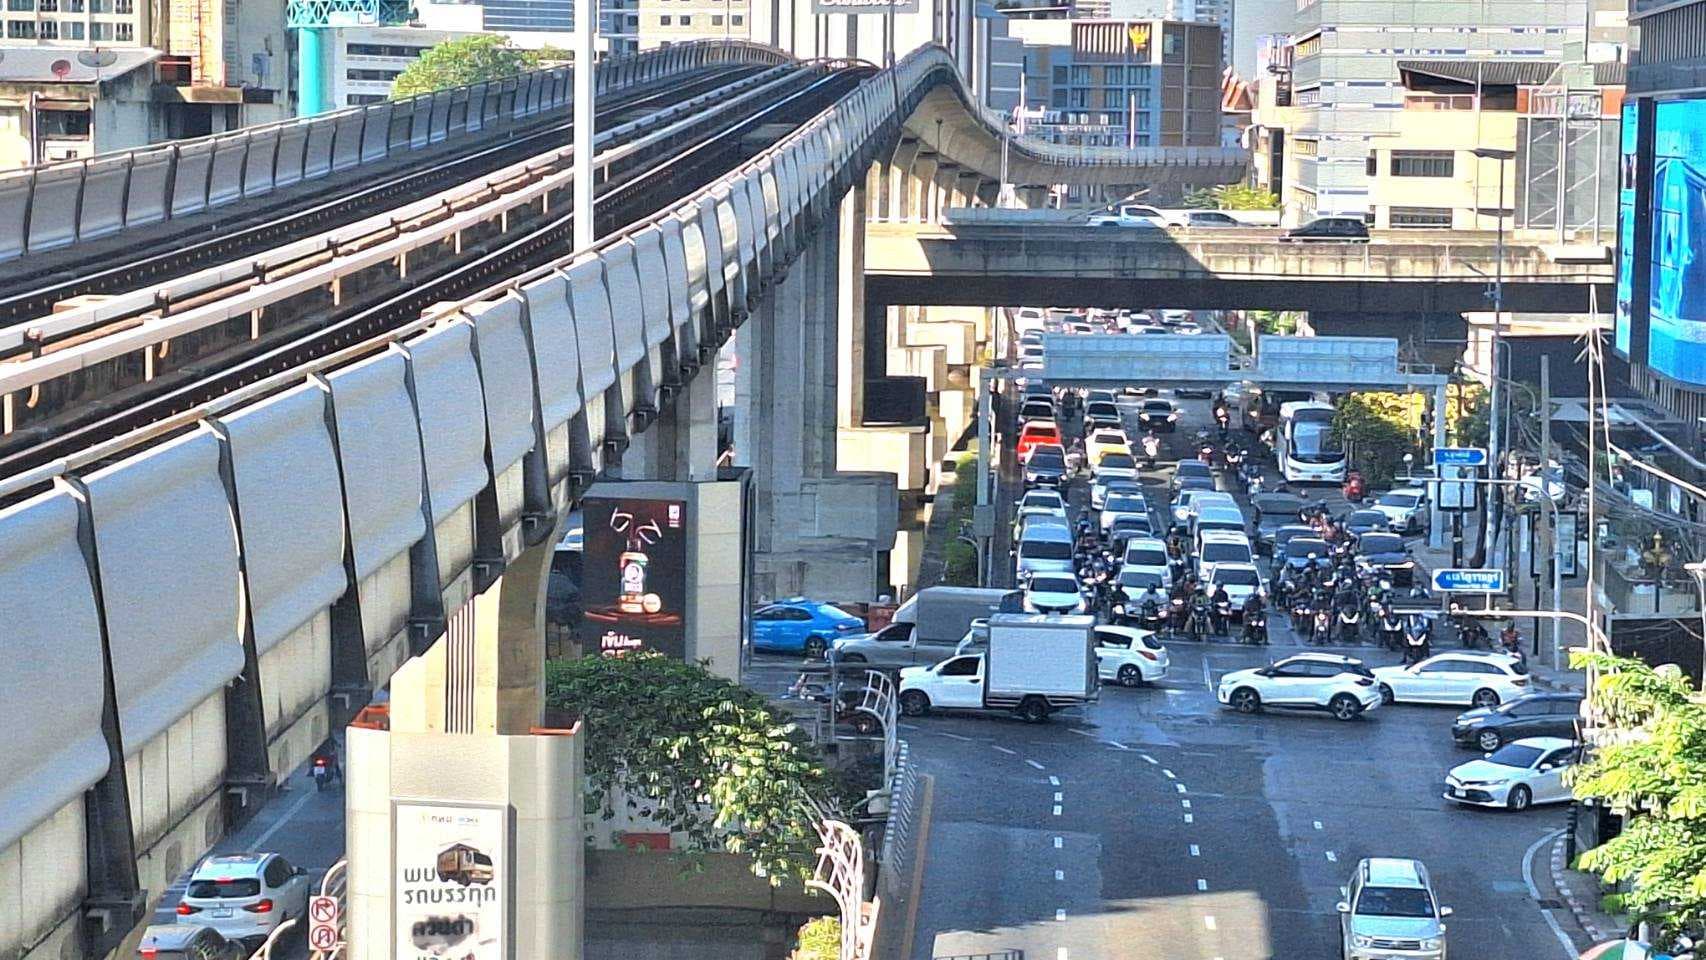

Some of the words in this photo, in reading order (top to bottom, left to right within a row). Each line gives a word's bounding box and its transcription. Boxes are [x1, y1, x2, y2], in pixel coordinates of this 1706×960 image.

[404, 867, 436, 883] พบ
[404, 887, 496, 908] รถบรรทุก
